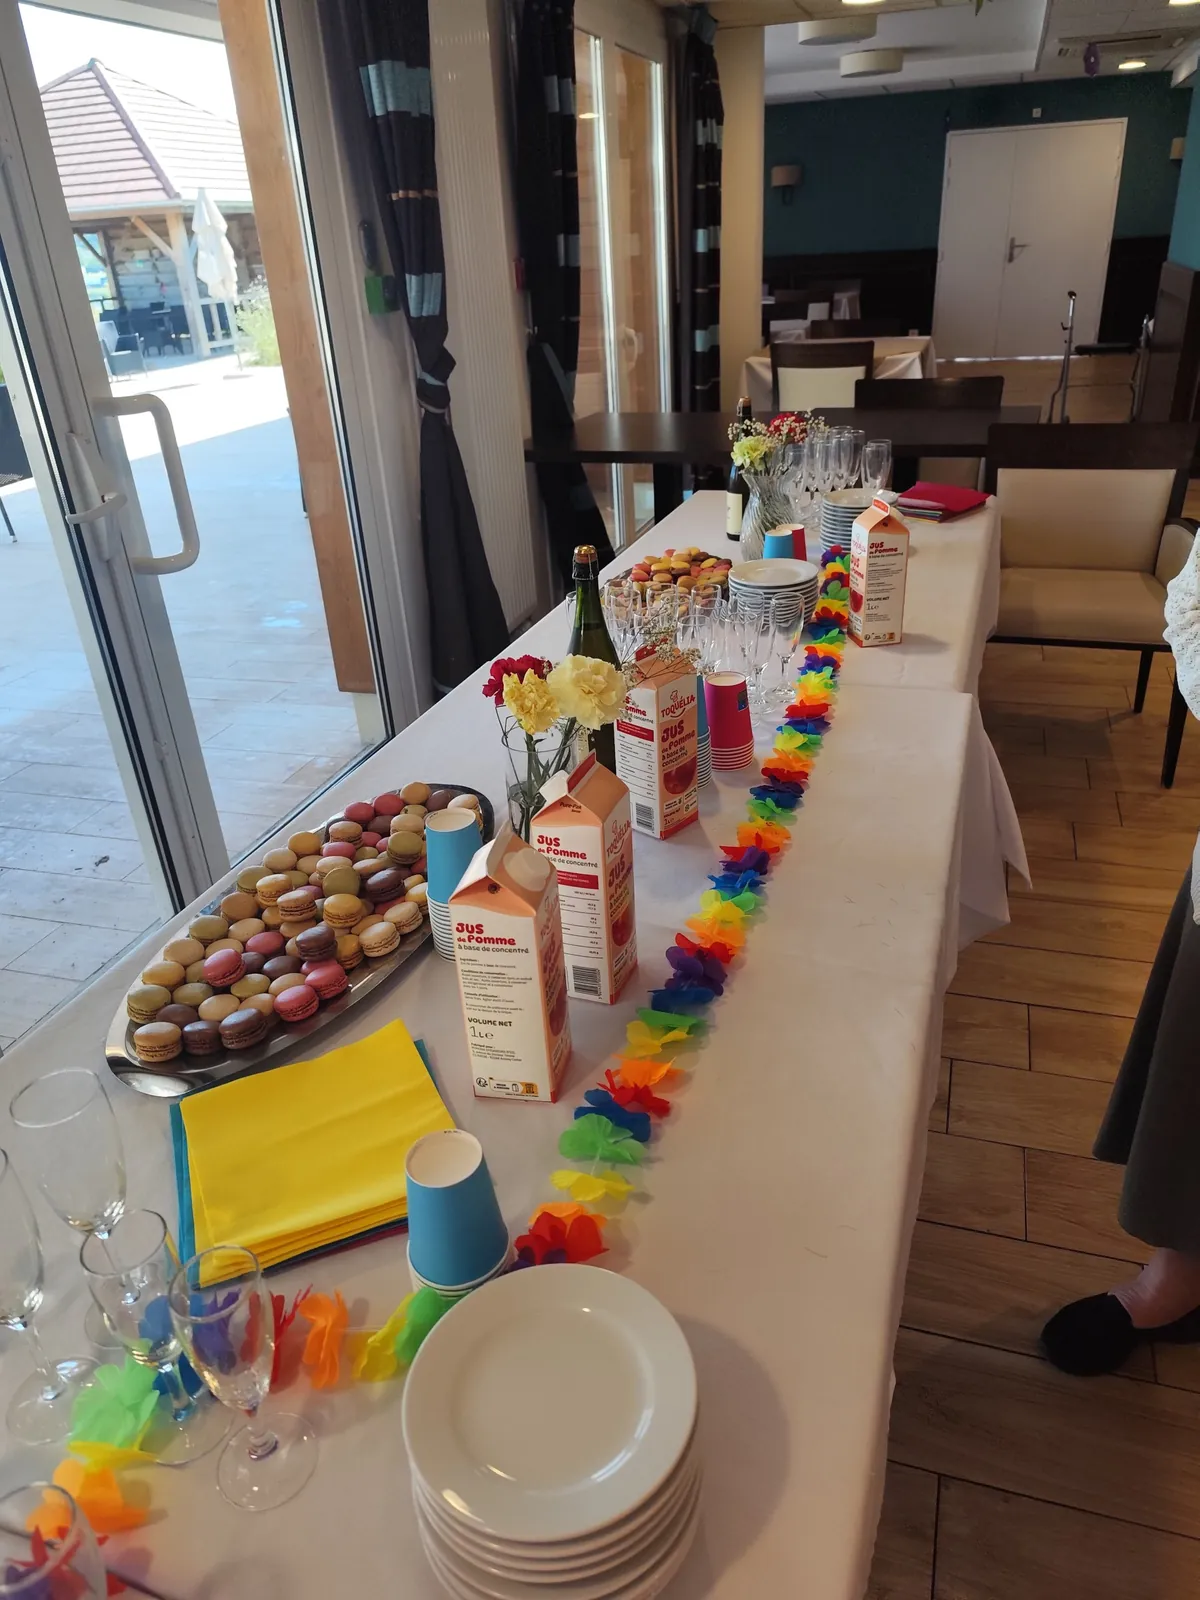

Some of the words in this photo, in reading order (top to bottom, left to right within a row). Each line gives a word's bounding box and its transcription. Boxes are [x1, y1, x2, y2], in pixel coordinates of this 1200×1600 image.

[625, 706, 647, 716] omme
[662, 720, 684, 742] JUS
[537, 835, 560, 847] JUS
[546, 847, 587, 860] Pomme
[456, 922, 484, 934] JUS
[467, 935, 516, 945] Pomme
[468, 1017, 497, 1026] VOLUME
